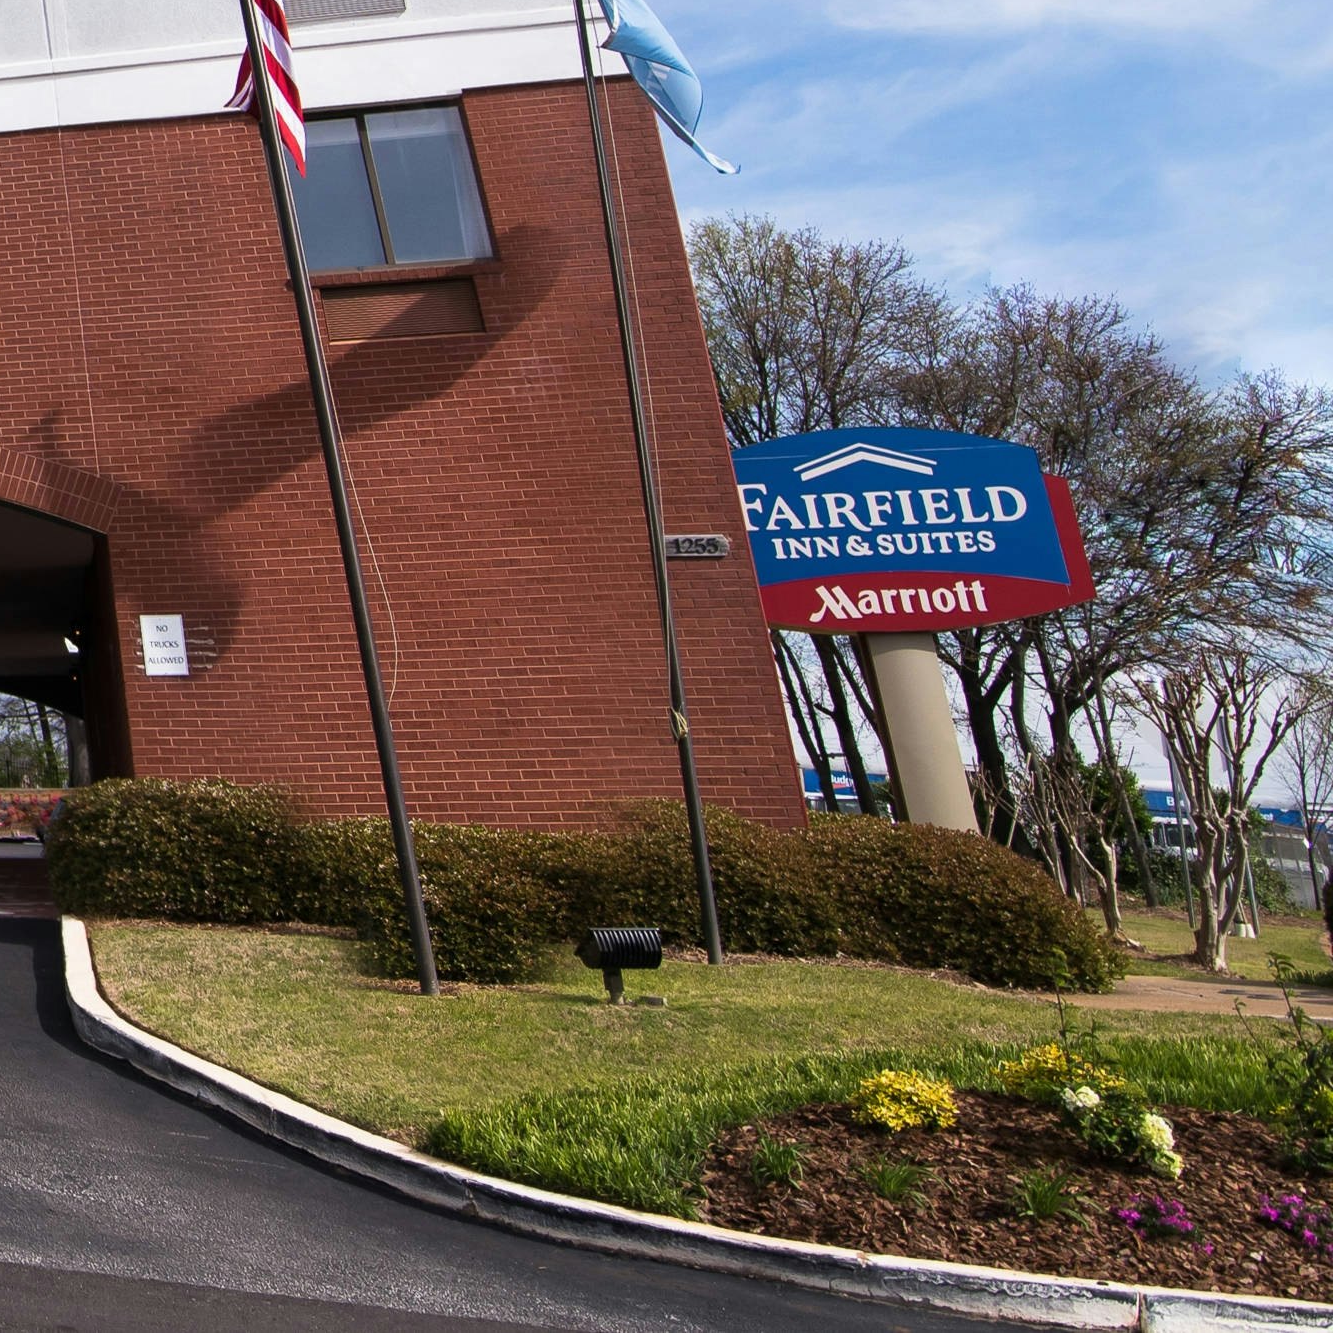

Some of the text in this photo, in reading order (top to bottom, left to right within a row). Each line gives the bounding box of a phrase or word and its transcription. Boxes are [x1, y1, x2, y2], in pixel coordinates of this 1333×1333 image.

[737, 483, 1028, 533] FAIRFIELD
[673, 537, 720, 554] 1255
[771, 530, 997, 559] INN & SUITES
[809, 579, 989, 623] Marriott
